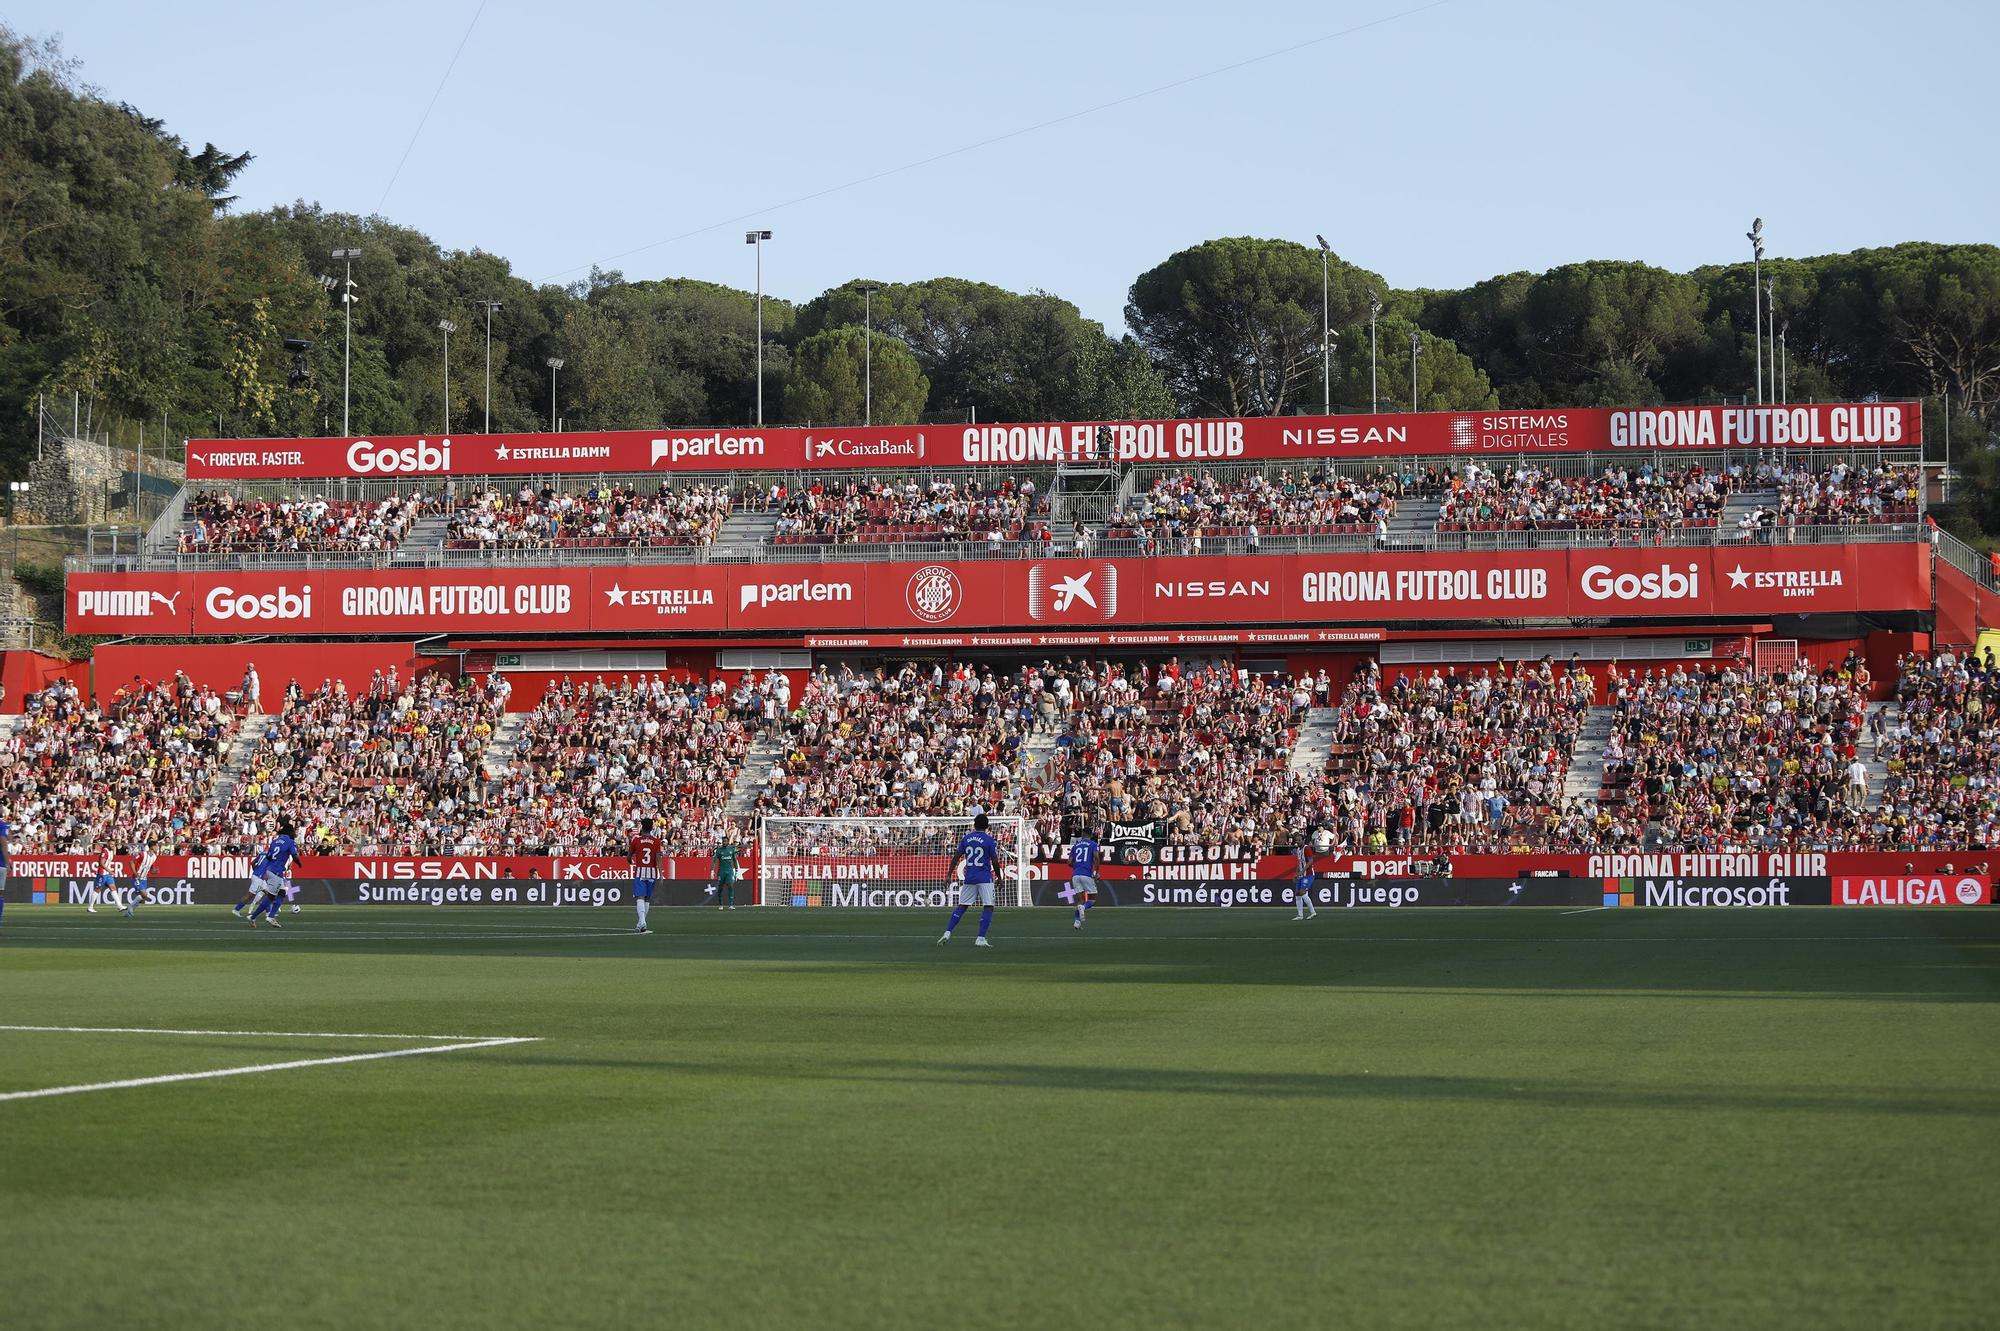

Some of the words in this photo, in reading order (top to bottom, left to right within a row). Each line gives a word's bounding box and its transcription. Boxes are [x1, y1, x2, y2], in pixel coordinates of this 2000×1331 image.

[1482, 415, 1568, 431] SISTEMAS
[1610, 409, 1716, 447] GIRONA
[1722, 407, 1825, 446] FUTBOL
[1830, 406, 1901, 443] CLUB
[963, 426, 1064, 462] GIRONA
[1176, 421, 1244, 458] CLUB
[1283, 426, 1406, 446] NISSAN
[1483, 432, 1568, 448] DIGITALES
[347, 439, 451, 473] Gosbi
[513, 446, 570, 460] ESTRELLA
[573, 446, 610, 458] DAMM
[672, 433, 764, 462] parlem
[838, 439, 915, 456] CaixaBank
[209, 452, 260, 466] FOREVER.
[262, 451, 304, 466] FASTER.
[916, 568, 952, 581] GIRONA
[1581, 563, 1698, 600] Gosbi
[1755, 570, 1843, 588] ESTRELLA
[762, 579, 852, 607] parlem
[1155, 581, 1270, 597] NISSAN
[1302, 571, 1391, 602] GIRONA
[1396, 569, 1482, 601] FUTBOL
[1487, 568, 1547, 600] CLUB
[1783, 588, 1814, 597] DAMM
[206, 585, 311, 620] Gosbi
[342, 587, 424, 616] GIRONA
[429, 585, 510, 615] FUTBOL
[514, 584, 571, 614] CLUB
[631, 589, 714, 605] ESTRELLA
[657, 606, 687, 614] DAMM
[1048, 636, 1078, 644] ESTRELLA
[1080, 636, 1100, 644] DAMM
[1328, 632, 1358, 640] ESTRELLA
[1360, 632, 1380, 640] DAMM
[271, 846, 280, 860] 2
[641, 847, 651, 865] 3
[965, 846, 985, 867] 22
[1075, 847, 1089, 862] 21
[13, 861, 73, 878] FOREVER.
[77, 861, 127, 877] FASER.
[187, 856, 256, 879] GIRON
[354, 862, 497, 880] NISSAN
[837, 864, 889, 879] DAMM
[1588, 854, 1675, 878] GIRONA
[1680, 853, 1758, 877] FUTBOL
[1768, 853, 1827, 877] CLUB
[359, 882, 482, 906] Sumérgete
[491, 888, 518, 902] en
[527, 883, 546, 902] el
[553, 883, 621, 907] juego
[832, 882, 961, 907] Microsof
[1143, 883, 1272, 907] Sumérgete
[1319, 883, 1339, 903] el
[1347, 883, 1419, 908] juego
[1645, 878, 1790, 907] Microsoft
[1843, 878, 1946, 905] LALIGA
[1961, 884, 1976, 892] EA
